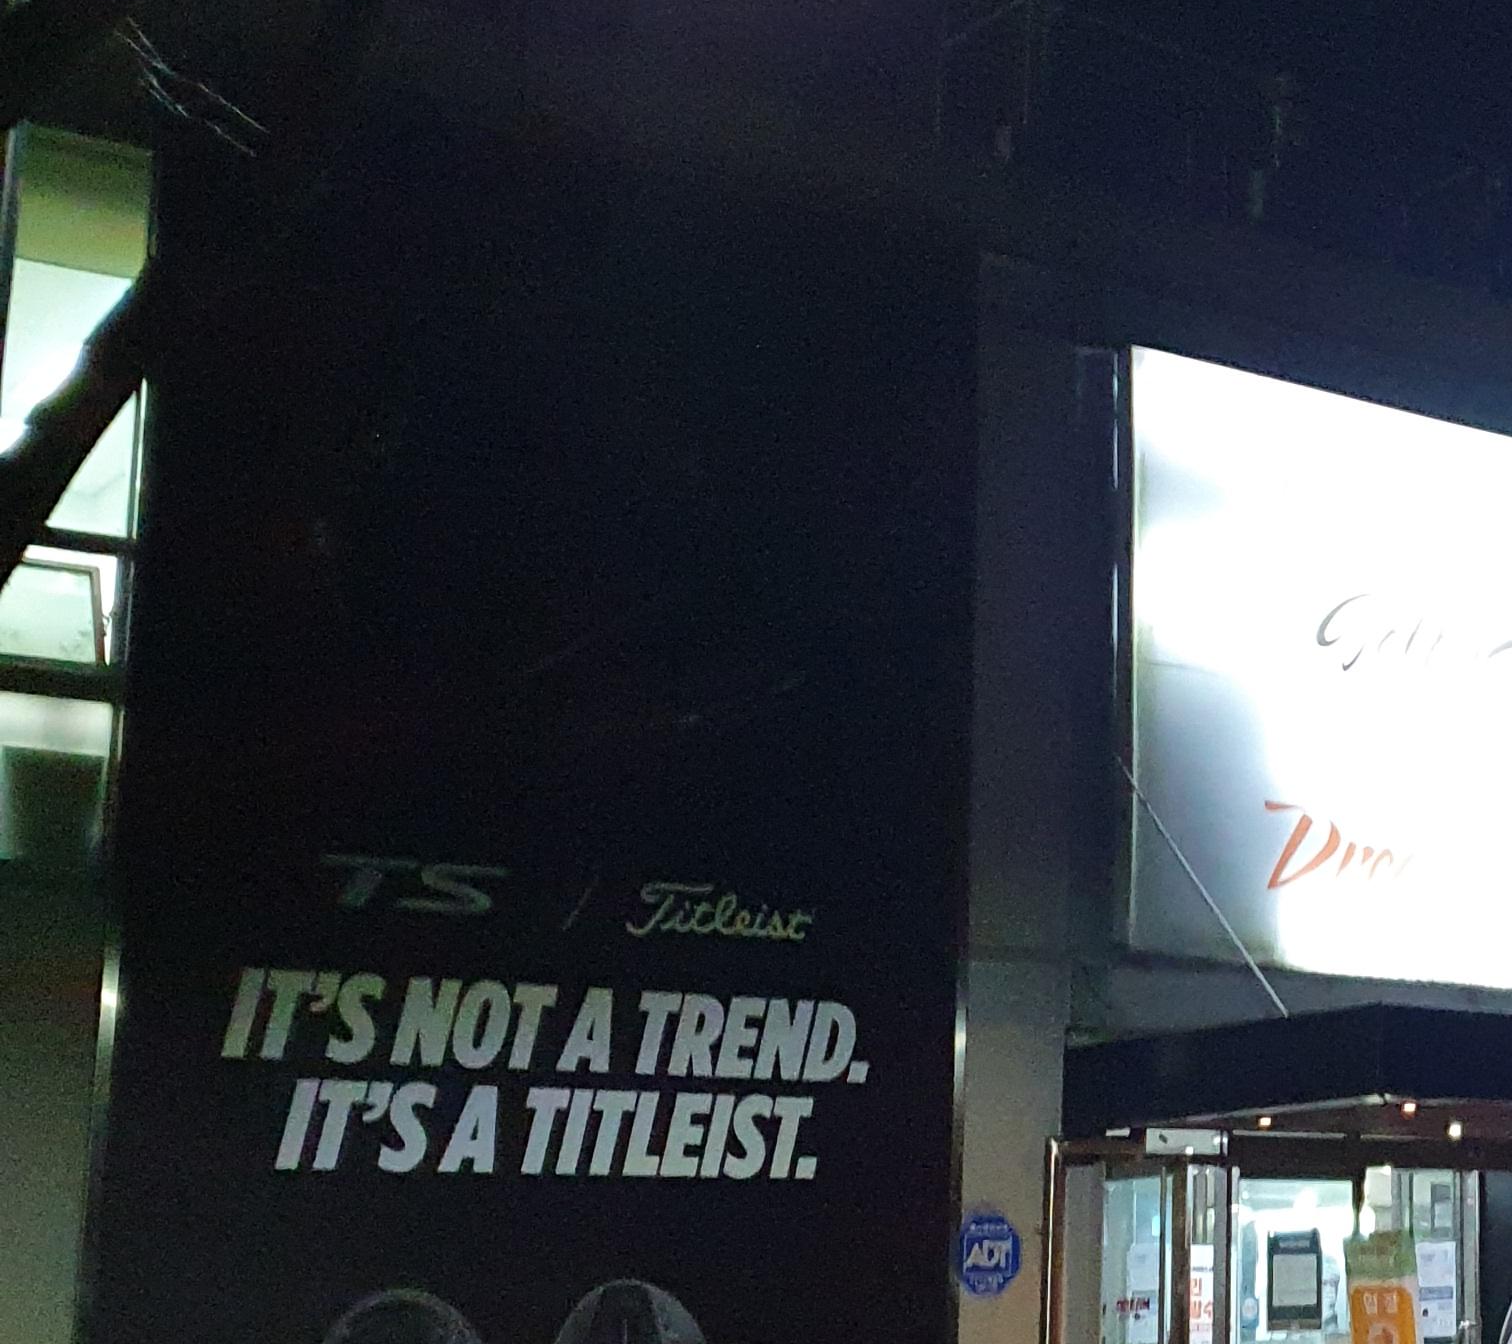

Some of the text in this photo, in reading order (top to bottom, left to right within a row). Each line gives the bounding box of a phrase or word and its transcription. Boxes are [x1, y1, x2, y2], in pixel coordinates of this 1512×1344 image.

[320, 853, 815, 942] TS Titleist
[221, 968, 871, 1084] IT'S NOT A TREND.
[274, 1078, 818, 1181] IT'S A TITLEIST.
[965, 1238, 1012, 1270] ADT
